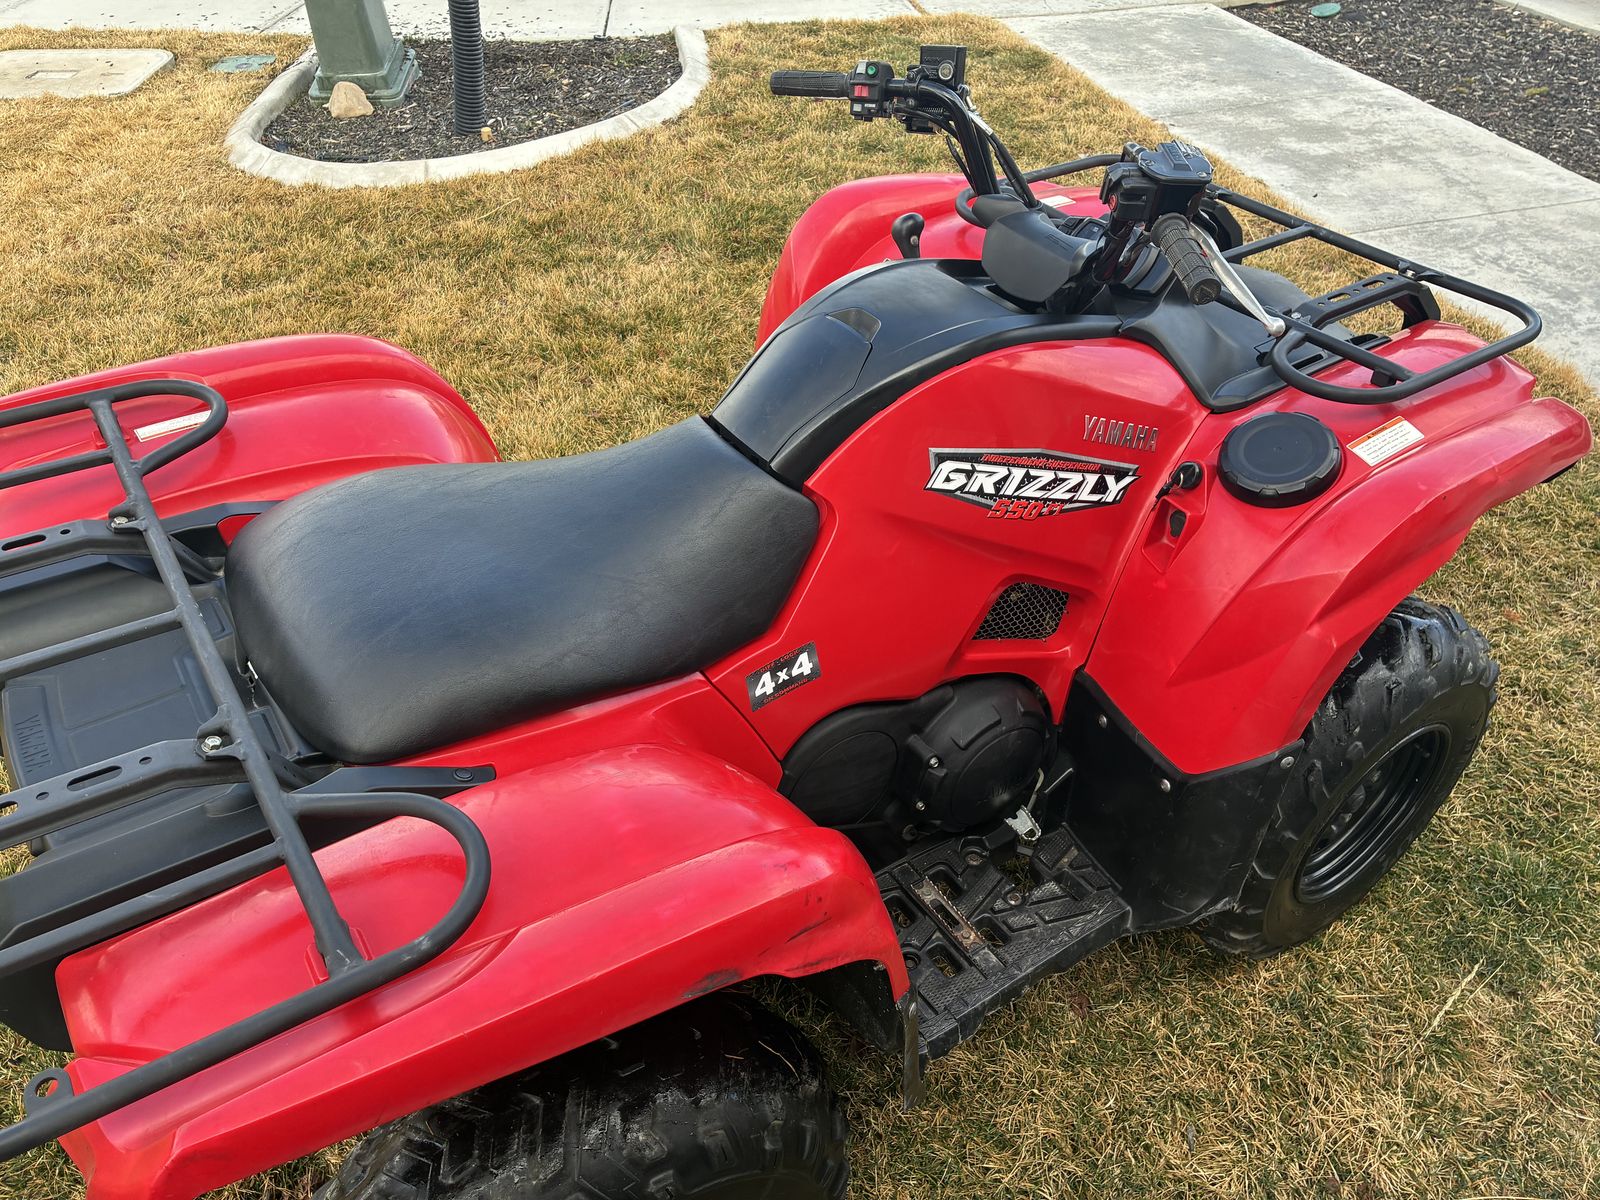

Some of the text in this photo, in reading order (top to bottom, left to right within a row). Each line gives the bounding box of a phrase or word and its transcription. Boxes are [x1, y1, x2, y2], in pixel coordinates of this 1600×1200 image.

[1082, 414, 1159, 452] YAMAHA
[925, 460, 1139, 504] GRIZZLY
[981, 453, 1102, 472] INDEPENDENT SUSPENSION
[986, 499, 1044, 520] 550
[755, 651, 813, 697] 4x4
[15, 713, 51, 775] YAMAHA
